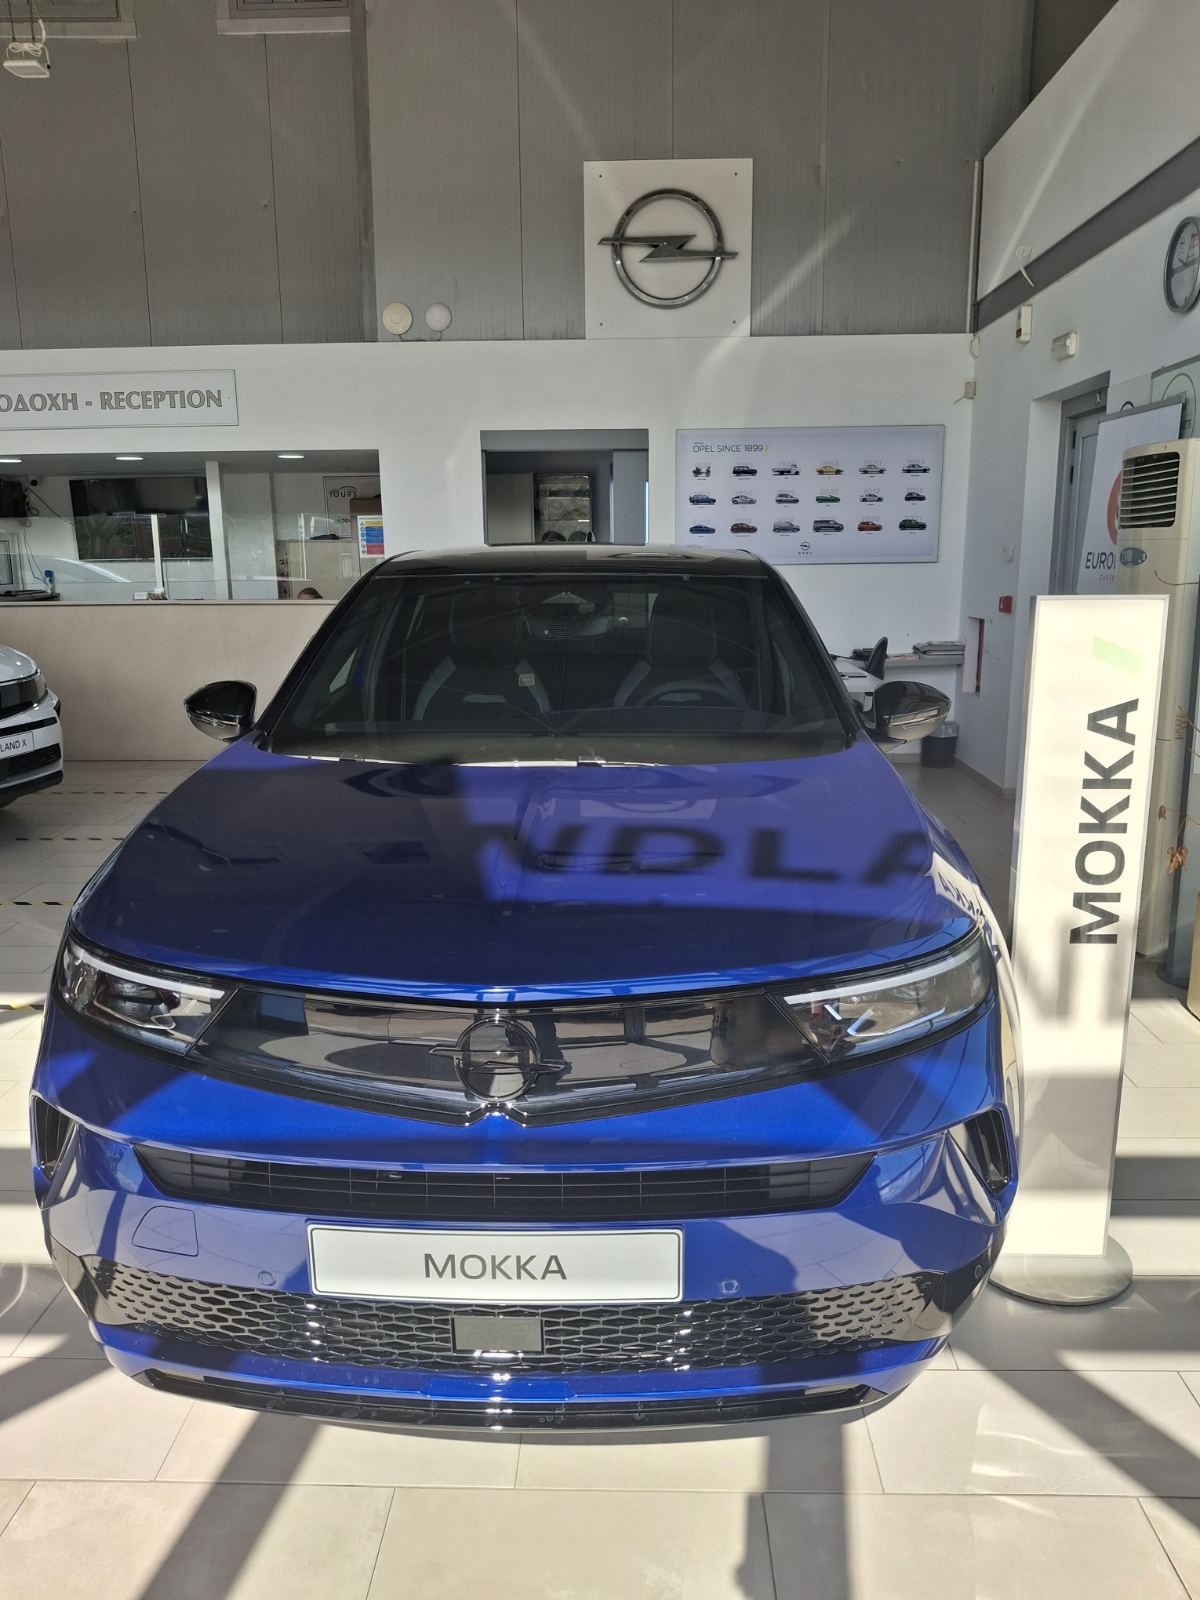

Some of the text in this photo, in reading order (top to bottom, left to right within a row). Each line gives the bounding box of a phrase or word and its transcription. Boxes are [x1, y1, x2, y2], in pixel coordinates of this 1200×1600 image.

[100, 389, 223, 410] RECEPTION
[692, 444, 714, 453] OPEL
[717, 444, 742, 453] SINCE
[1085, 551, 1116, 570] EURO
[1069, 698, 1140, 945] MOKKA
[423, 1252, 568, 1281] MOKKA
